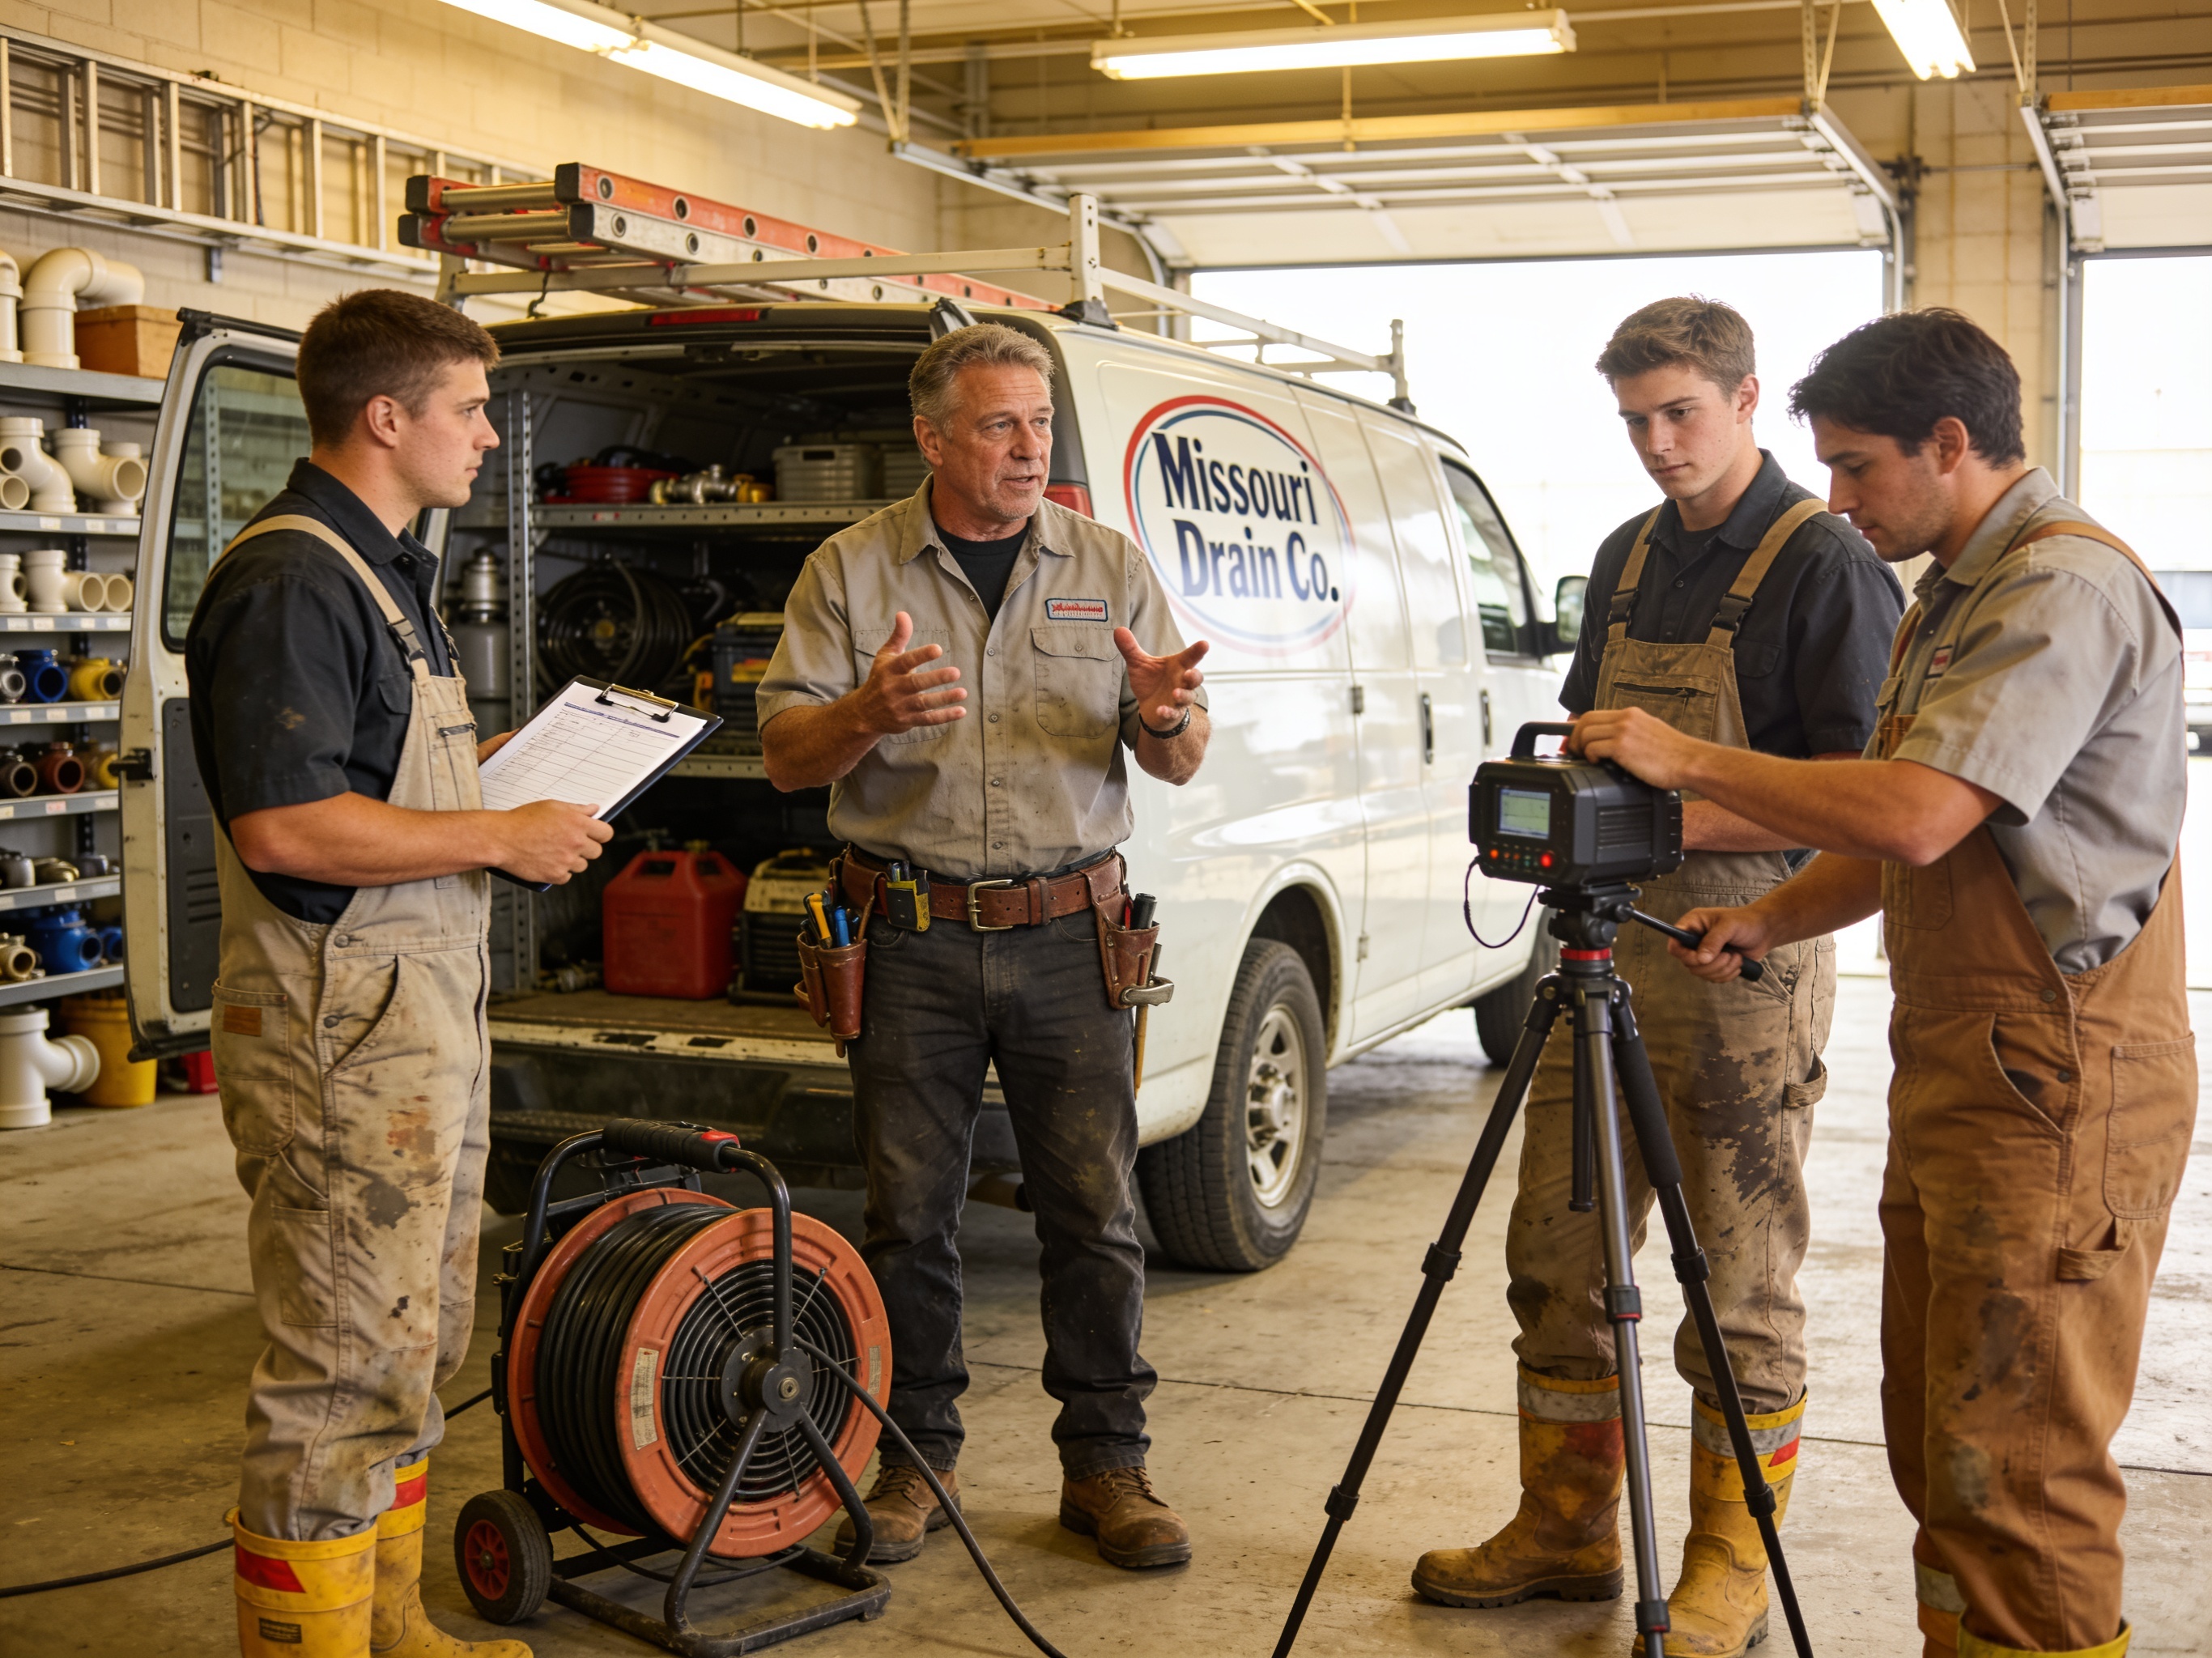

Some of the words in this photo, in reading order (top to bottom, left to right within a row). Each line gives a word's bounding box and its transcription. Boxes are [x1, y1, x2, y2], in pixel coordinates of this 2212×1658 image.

[1151, 432, 1318, 525] Missouri
[1172, 519, 1283, 599] Drain
[1287, 531, 1338, 602] Co.
